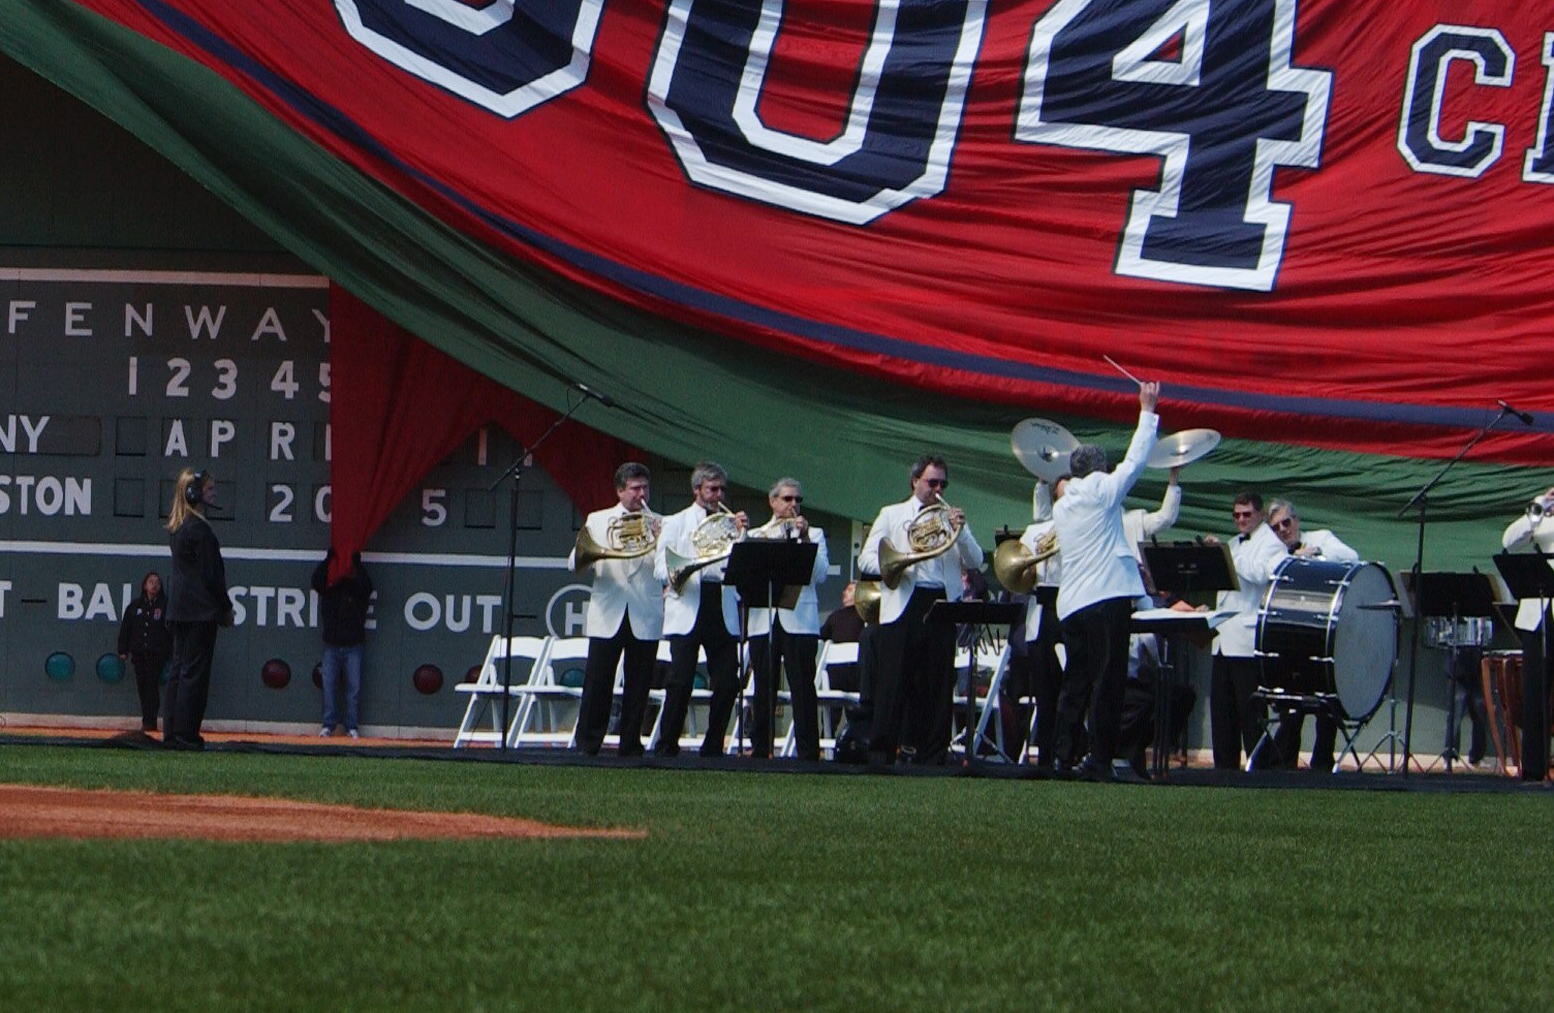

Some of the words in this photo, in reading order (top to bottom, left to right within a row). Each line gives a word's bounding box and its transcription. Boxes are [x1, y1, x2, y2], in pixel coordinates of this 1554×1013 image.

[128, 356, 138, 396] 1
[166, 357, 192, 397] 2
[211, 358, 239, 400] 3
[271, 359, 300, 400] 4
[403, 591, 502, 633] OUT
